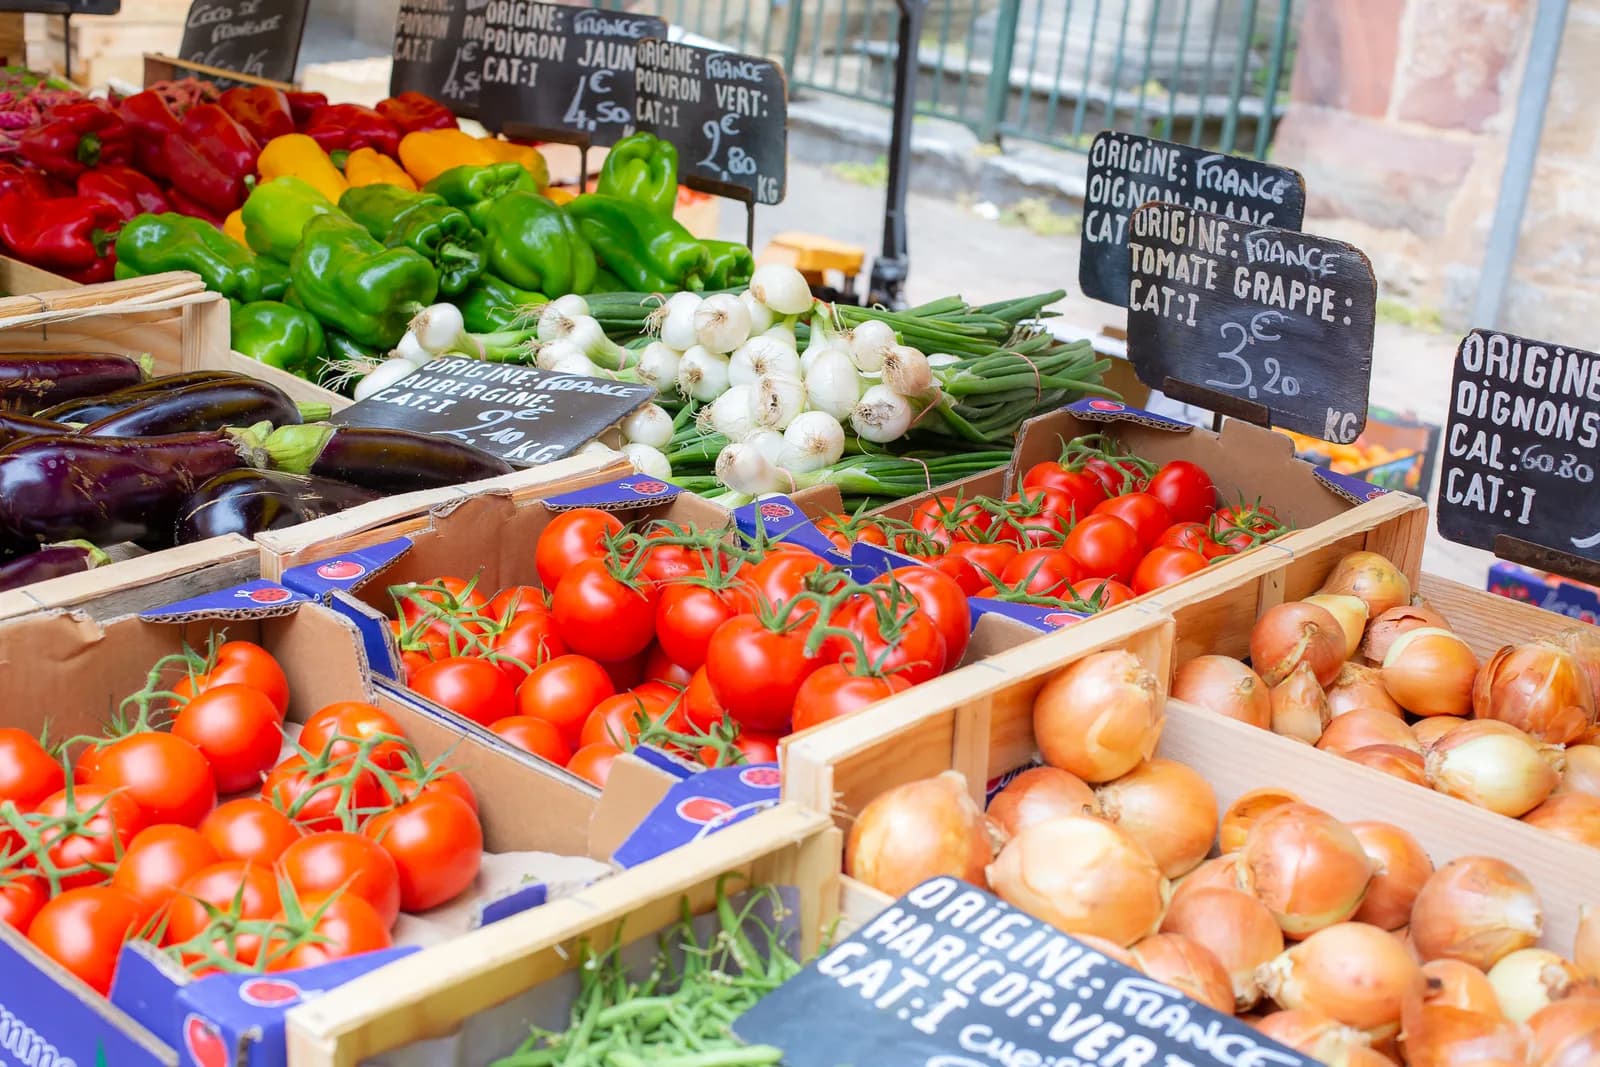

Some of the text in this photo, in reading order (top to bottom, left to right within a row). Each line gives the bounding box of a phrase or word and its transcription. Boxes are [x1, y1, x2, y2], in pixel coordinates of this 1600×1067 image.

[573, 9, 650, 39] FRANCE
[482, 28, 637, 72] POIVRON JAUN
[705, 53, 773, 83] FRANCE
[482, 56, 539, 87] CAT:I
[635, 67, 769, 118] POIVRON VERT:
[636, 98, 680, 128] CAT:I
[757, 175, 778, 203] KG
[1194, 154, 1293, 204] FRANCE
[1085, 209, 1128, 245] CAT
[1127, 242, 1219, 290] TOMATE
[1244, 227, 1340, 276] FRANCE
[1129, 279, 1200, 327] CAT:I
[370, 388, 458, 414] CAT:I
[533, 374, 644, 397] FRANCE
[1324, 407, 1358, 443] KG
[502, 439, 565, 464] KG
[1446, 467, 1537, 525] CAT:I
[816, 941, 970, 1035] CAT:I
[1102, 976, 1302, 1067] FRANCE
